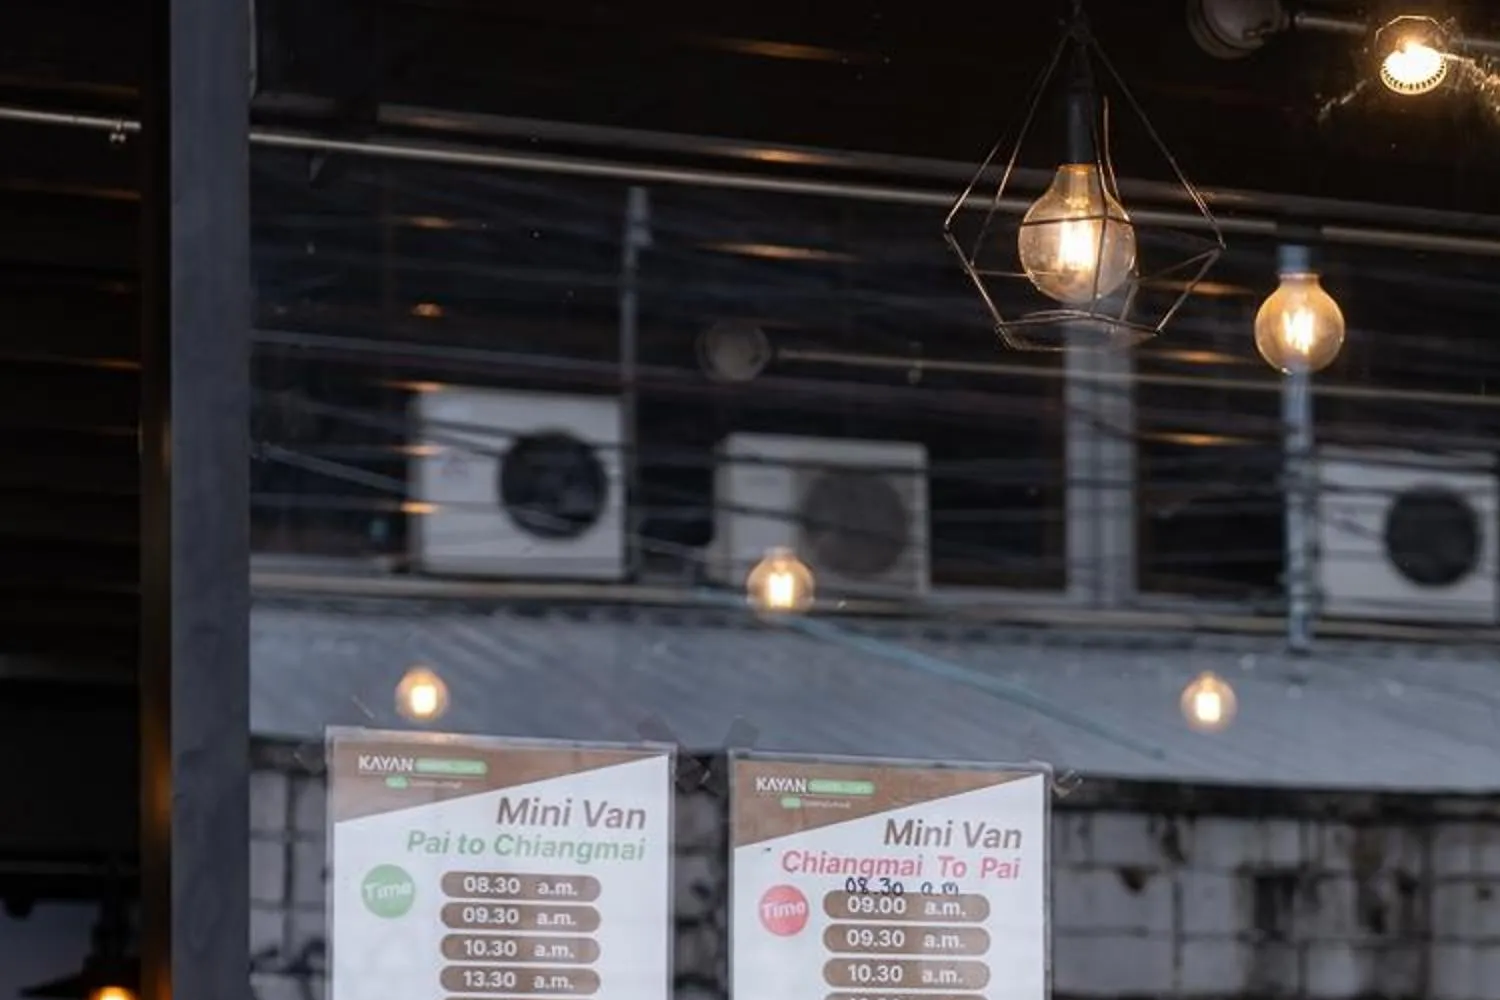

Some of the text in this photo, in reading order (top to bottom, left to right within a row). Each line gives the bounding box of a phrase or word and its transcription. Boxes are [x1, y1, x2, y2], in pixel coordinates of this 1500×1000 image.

[358, 756, 414, 772] KAYAN
[756, 777, 807, 793] KAYAN
[496, 797, 646, 830] Mini Van
[884, 818, 1022, 849] Mini Van
[407, 831, 646, 864] Pai to Chiangmai
[781, 850, 1021, 880] Chiangmai To Pai
[463, 877, 578, 896] 08.30 a.m.
[463, 907, 576, 926] 09.30 a.m.
[847, 896, 967, 917] 09.00 a.m.
[847, 929, 966, 949] 09.30 a.m.
[463, 940, 574, 959] 10.30 a.m.
[463, 971, 574, 990] 13.30 a.m.
[847, 964, 964, 984] 10.30 a.m.
